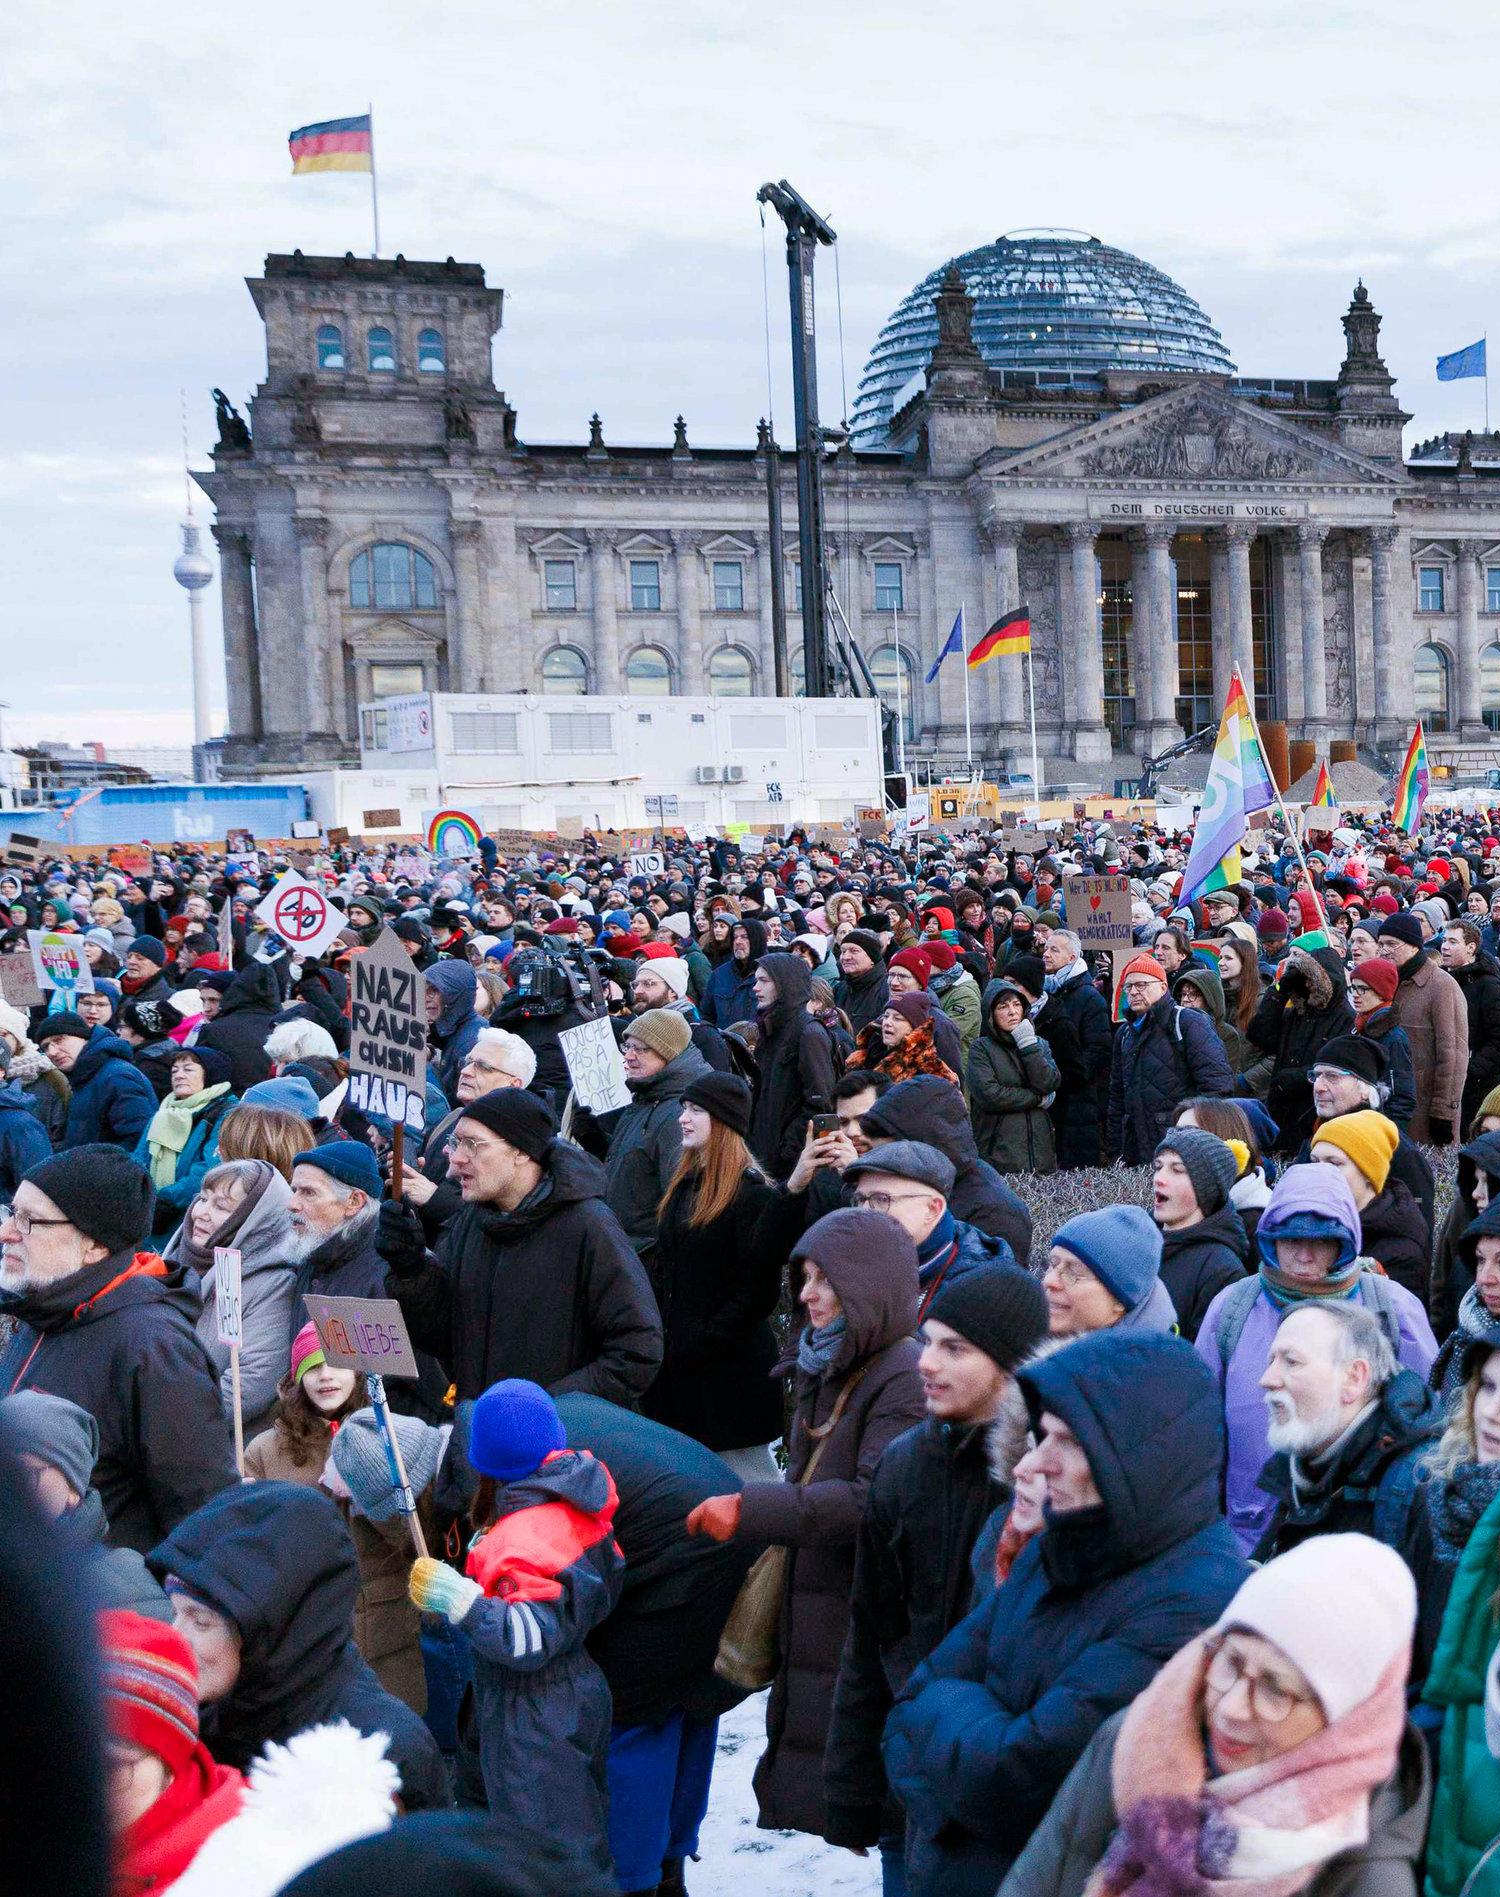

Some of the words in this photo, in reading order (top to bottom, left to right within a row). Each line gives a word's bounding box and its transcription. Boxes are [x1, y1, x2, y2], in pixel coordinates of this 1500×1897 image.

[1111, 503, 1142, 515] DEM
[1154, 503, 1234, 515] DEUTSCHEN
[1246, 504, 1287, 516] VOLKE
[767, 782, 781, 794] FCK
[862, 811, 881, 822] FCK
[635, 856, 660, 874] NO
[356, 960, 417, 1017] NAZI
[352, 1001, 426, 1050] RAUS
[560, 1018, 610, 1051] TOUCHE
[566, 1047, 593, 1073] PAS
[575, 1063, 612, 1094] MON
[350, 1069, 425, 1132] HAUS
[352, 1316, 402, 1355] LIEBE
